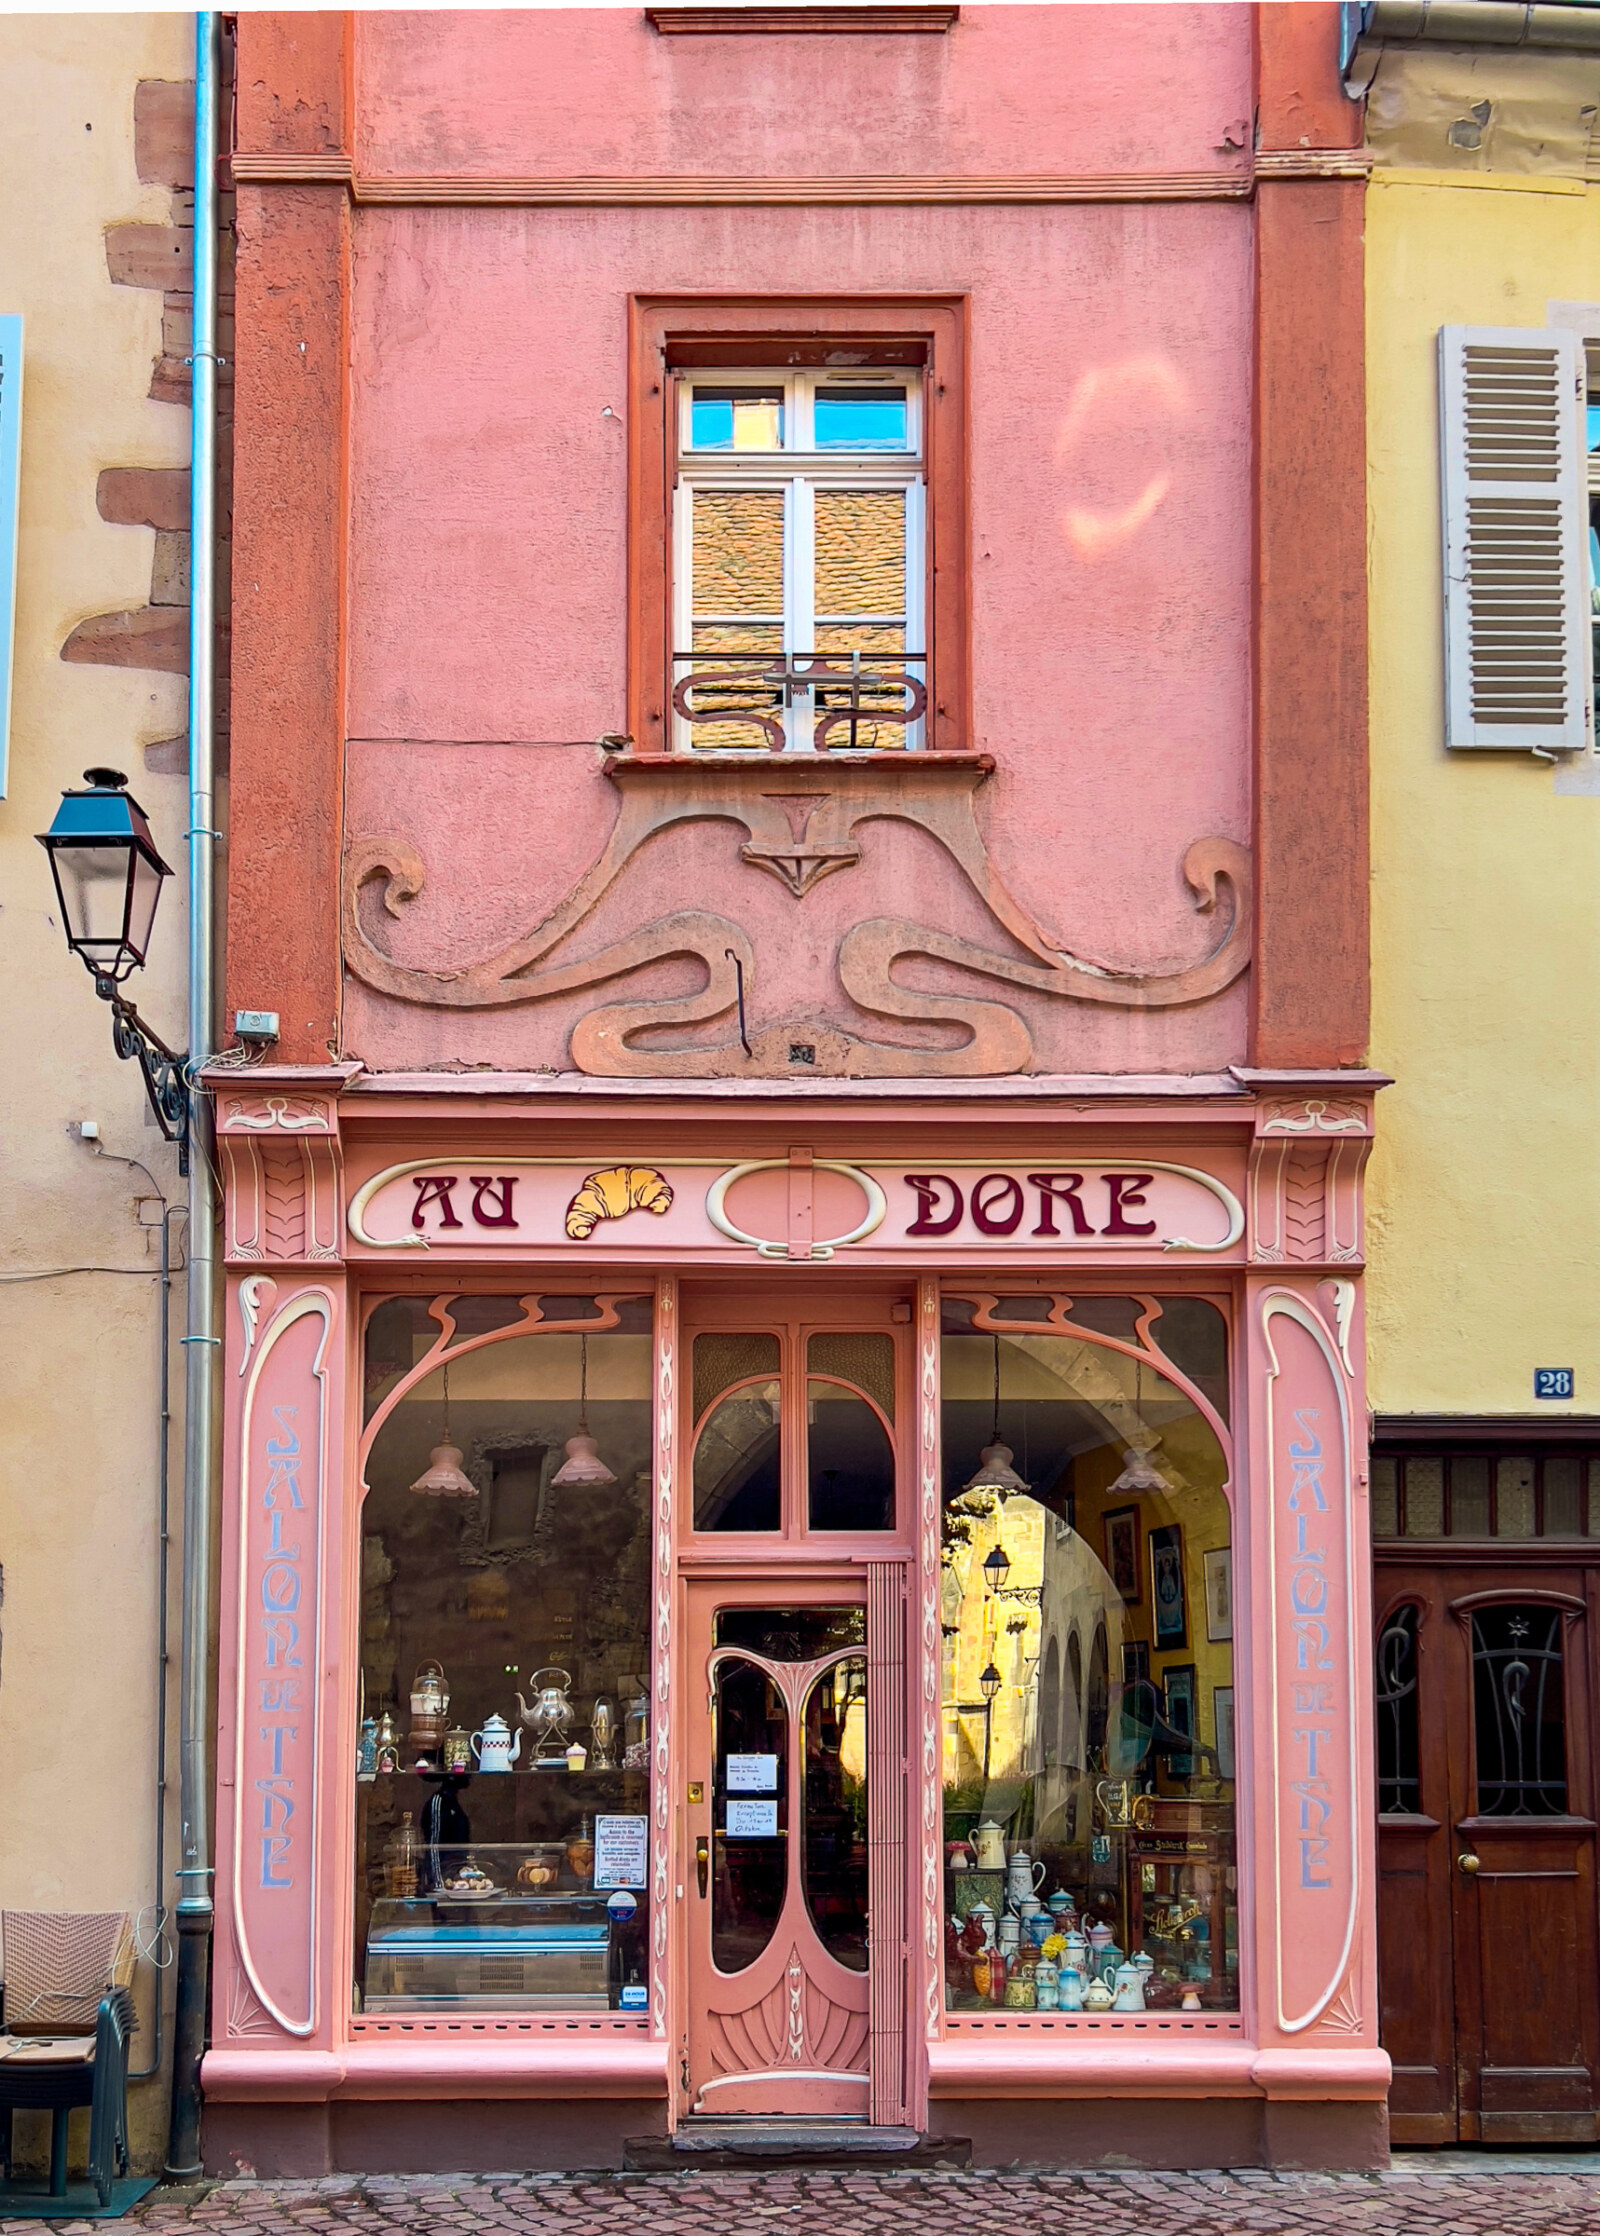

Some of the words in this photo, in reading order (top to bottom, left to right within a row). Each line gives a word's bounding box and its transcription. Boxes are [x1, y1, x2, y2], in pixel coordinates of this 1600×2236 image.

[411, 1176, 519, 1228] AU
[903, 1173, 1156, 1235] DORE
[1539, 1371, 1570, 1395] 28
[261, 1405, 306, 1668] SALON
[1287, 1409, 1334, 1671] SALON
[259, 1679, 302, 1712] DE
[1291, 1682, 1334, 1713] DE
